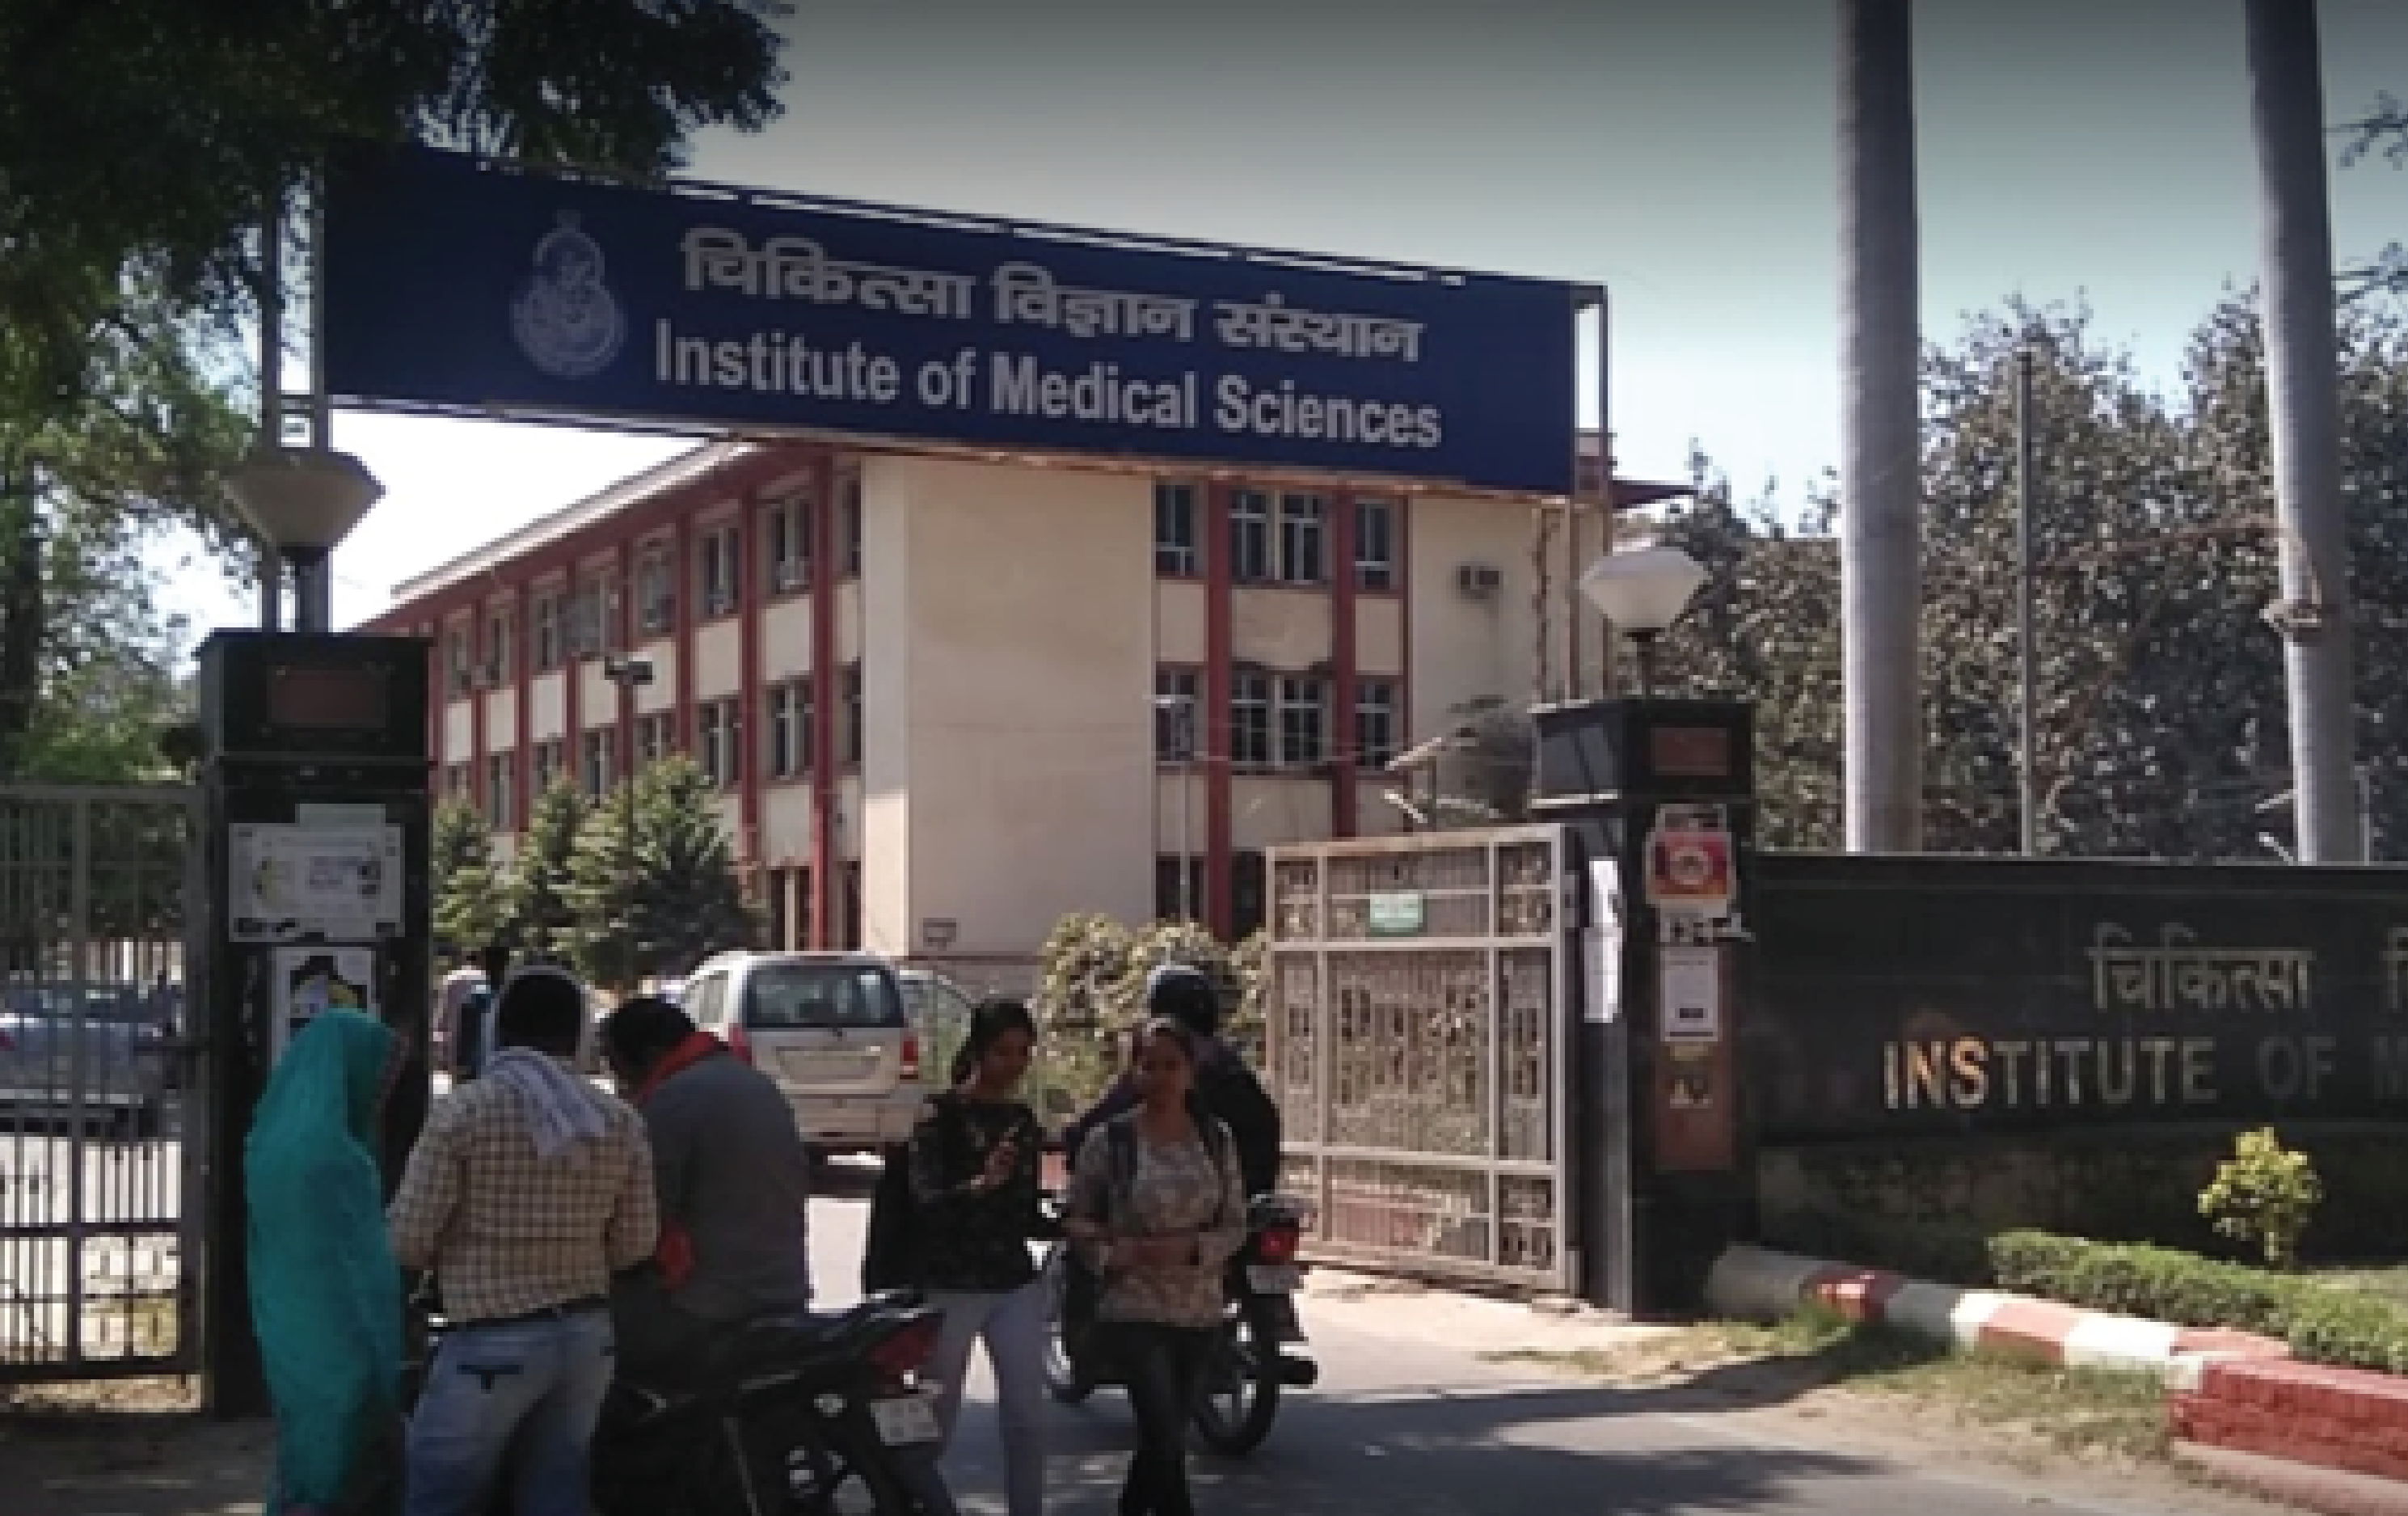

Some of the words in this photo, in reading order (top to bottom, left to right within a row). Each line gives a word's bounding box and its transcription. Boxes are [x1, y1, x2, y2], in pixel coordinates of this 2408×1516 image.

[681, 227, 976, 319] चिकित्सा
[990, 260, 1199, 341] विज्ञान
[1213, 290, 1428, 362] संस्थान
[656, 318, 900, 401] Institute
[917, 348, 976, 409] of
[989, 352, 1199, 429] Medical
[1217, 374, 1443, 448] Sciences
[2085, 922, 2316, 1009] चिकित्सा
[1883, 1036, 2218, 1109] INSTITUTE
[2258, 1036, 2337, 1100] OF
